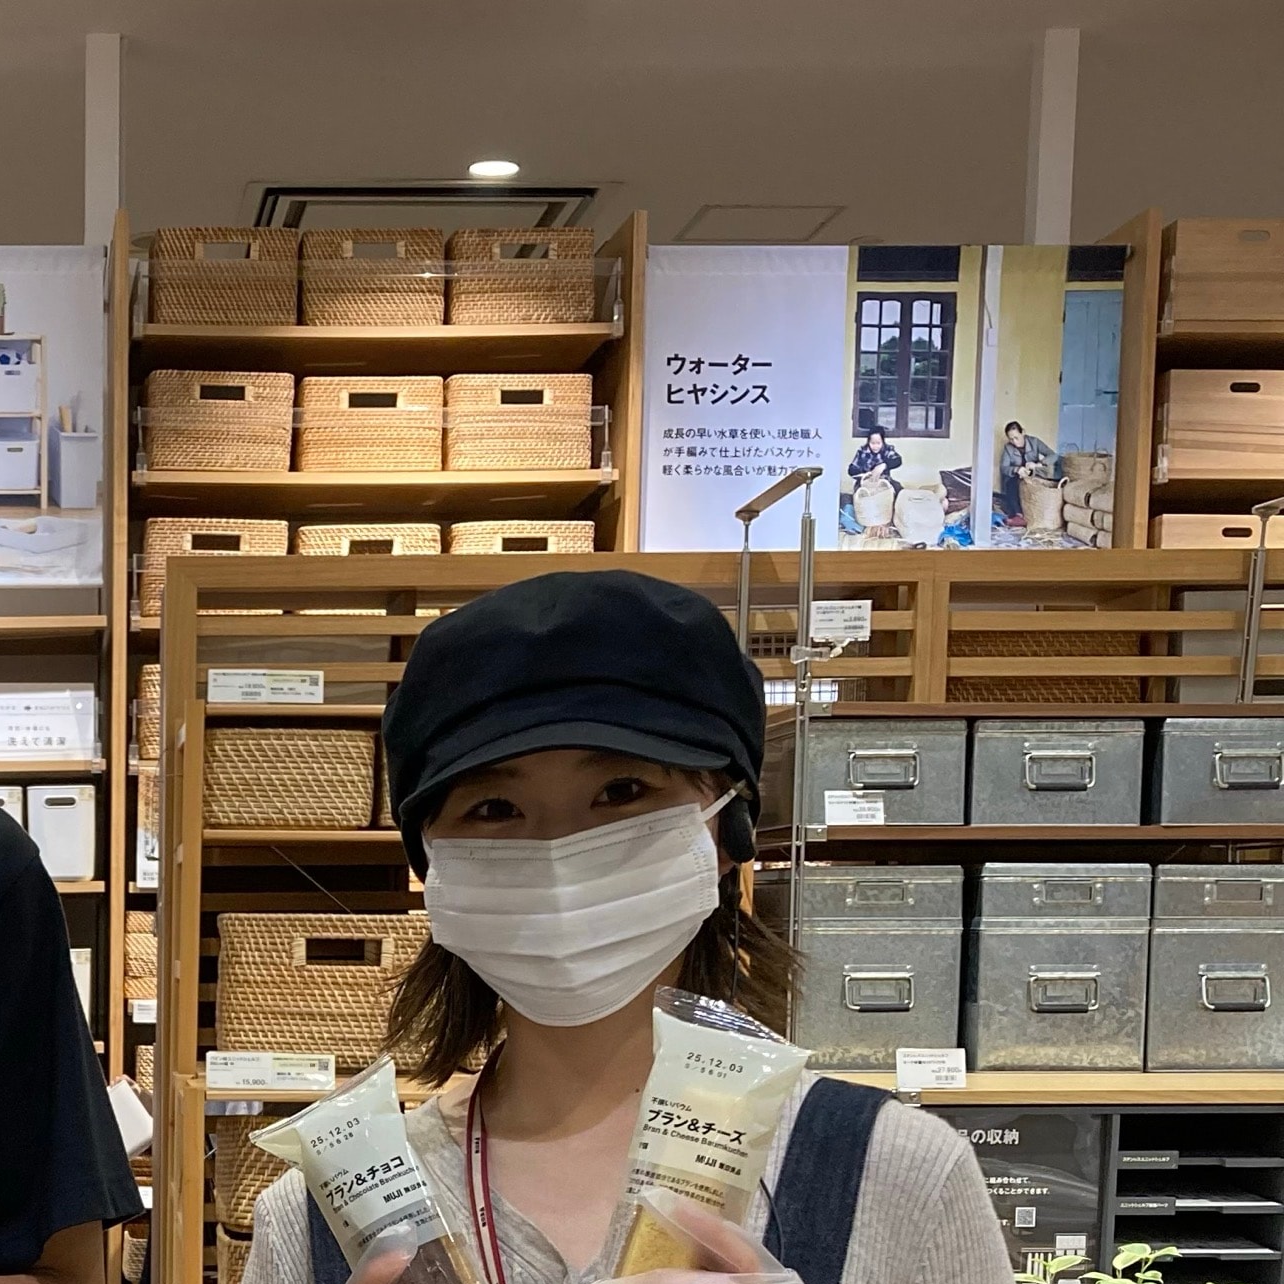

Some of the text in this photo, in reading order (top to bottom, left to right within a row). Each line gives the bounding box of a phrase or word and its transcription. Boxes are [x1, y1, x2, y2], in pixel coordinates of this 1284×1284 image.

[665, 353, 773, 376] ウォーター
[665, 382, 770, 406] ヒヤシンス
[662, 428, 823, 440] 成長の早い水草を使い、現地職人
[686, 1051, 745, 1074] 25.12.03
[310, 1117, 361, 1149] 25.12.03
[642, 1123, 661, 1135] Bran
[670, 1130, 700, 1144] Cheese
[647, 1108, 747, 1146] ブラン&チーズ
[694, 1154, 718, 1168] MUJI
[348, 1182, 380, 1203] Chocolate
[382, 1188, 404, 1204] MUJI
